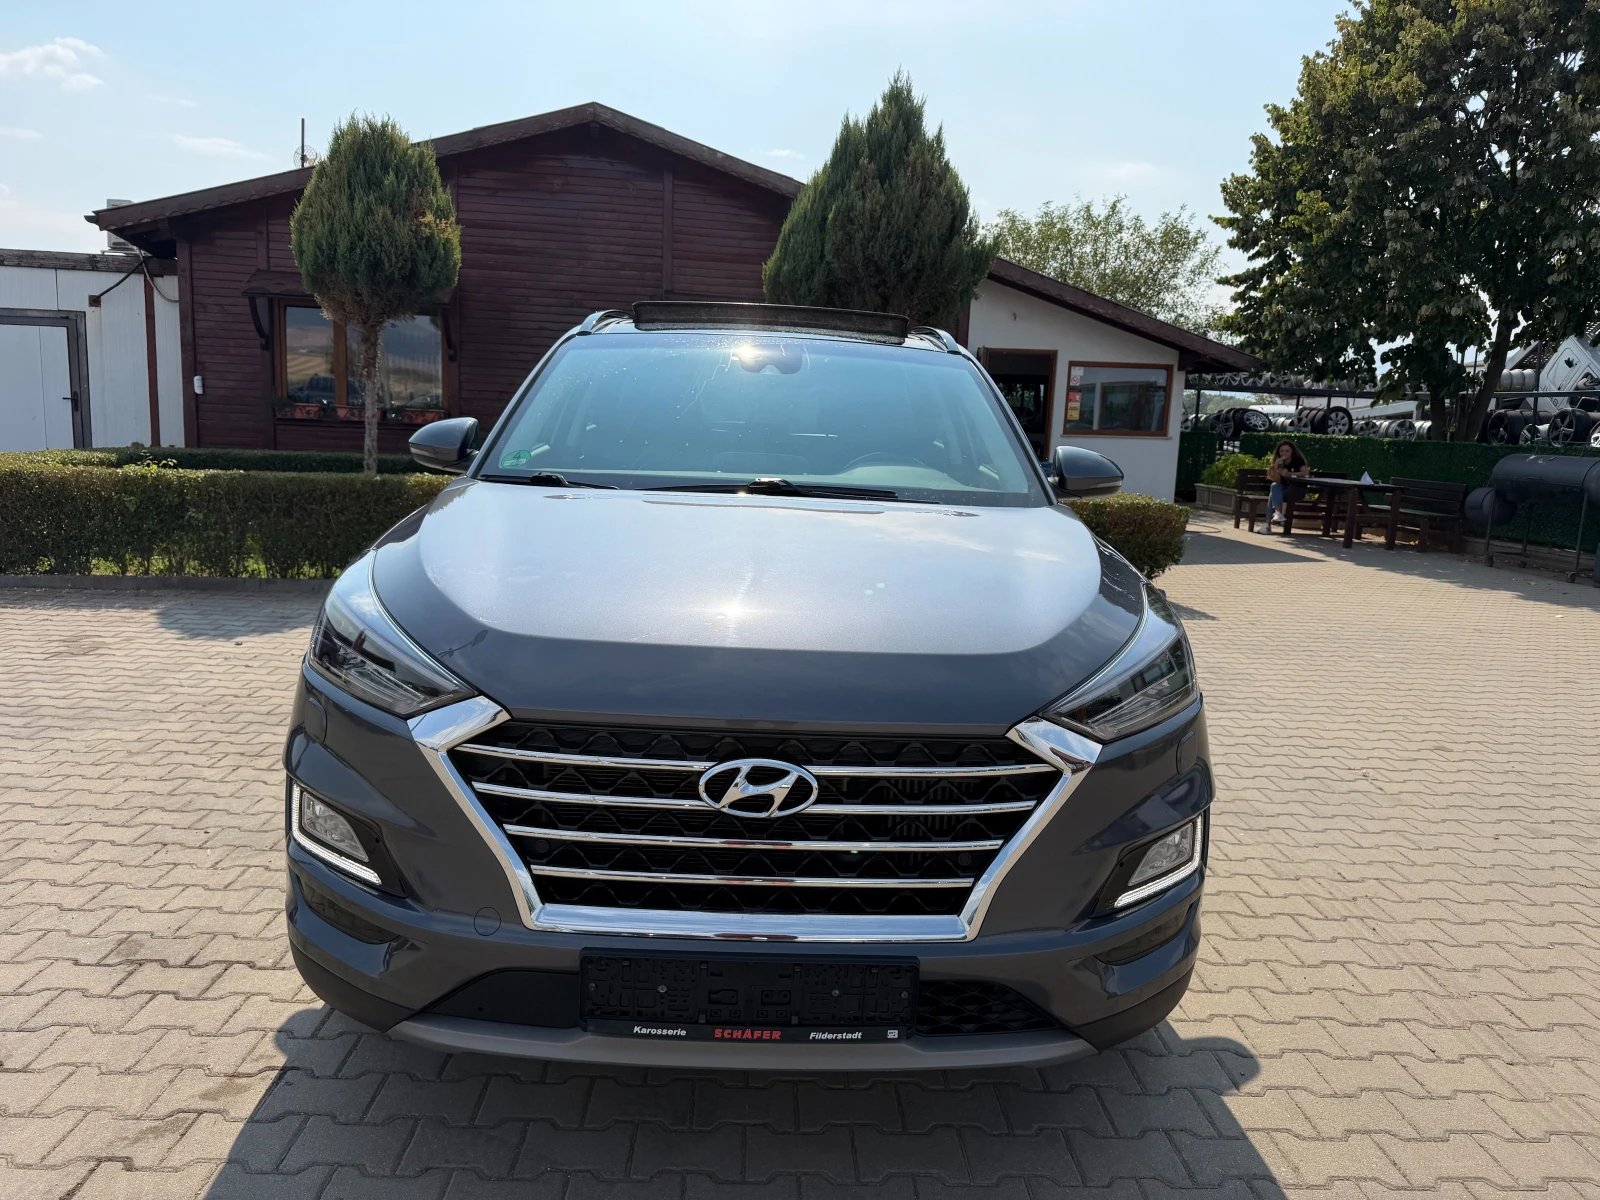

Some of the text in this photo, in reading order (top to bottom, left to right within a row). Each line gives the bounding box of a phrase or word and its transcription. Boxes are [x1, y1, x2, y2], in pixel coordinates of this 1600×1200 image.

[633, 1025, 862, 1040] Karosserie SCHÄFER Filderstadt
